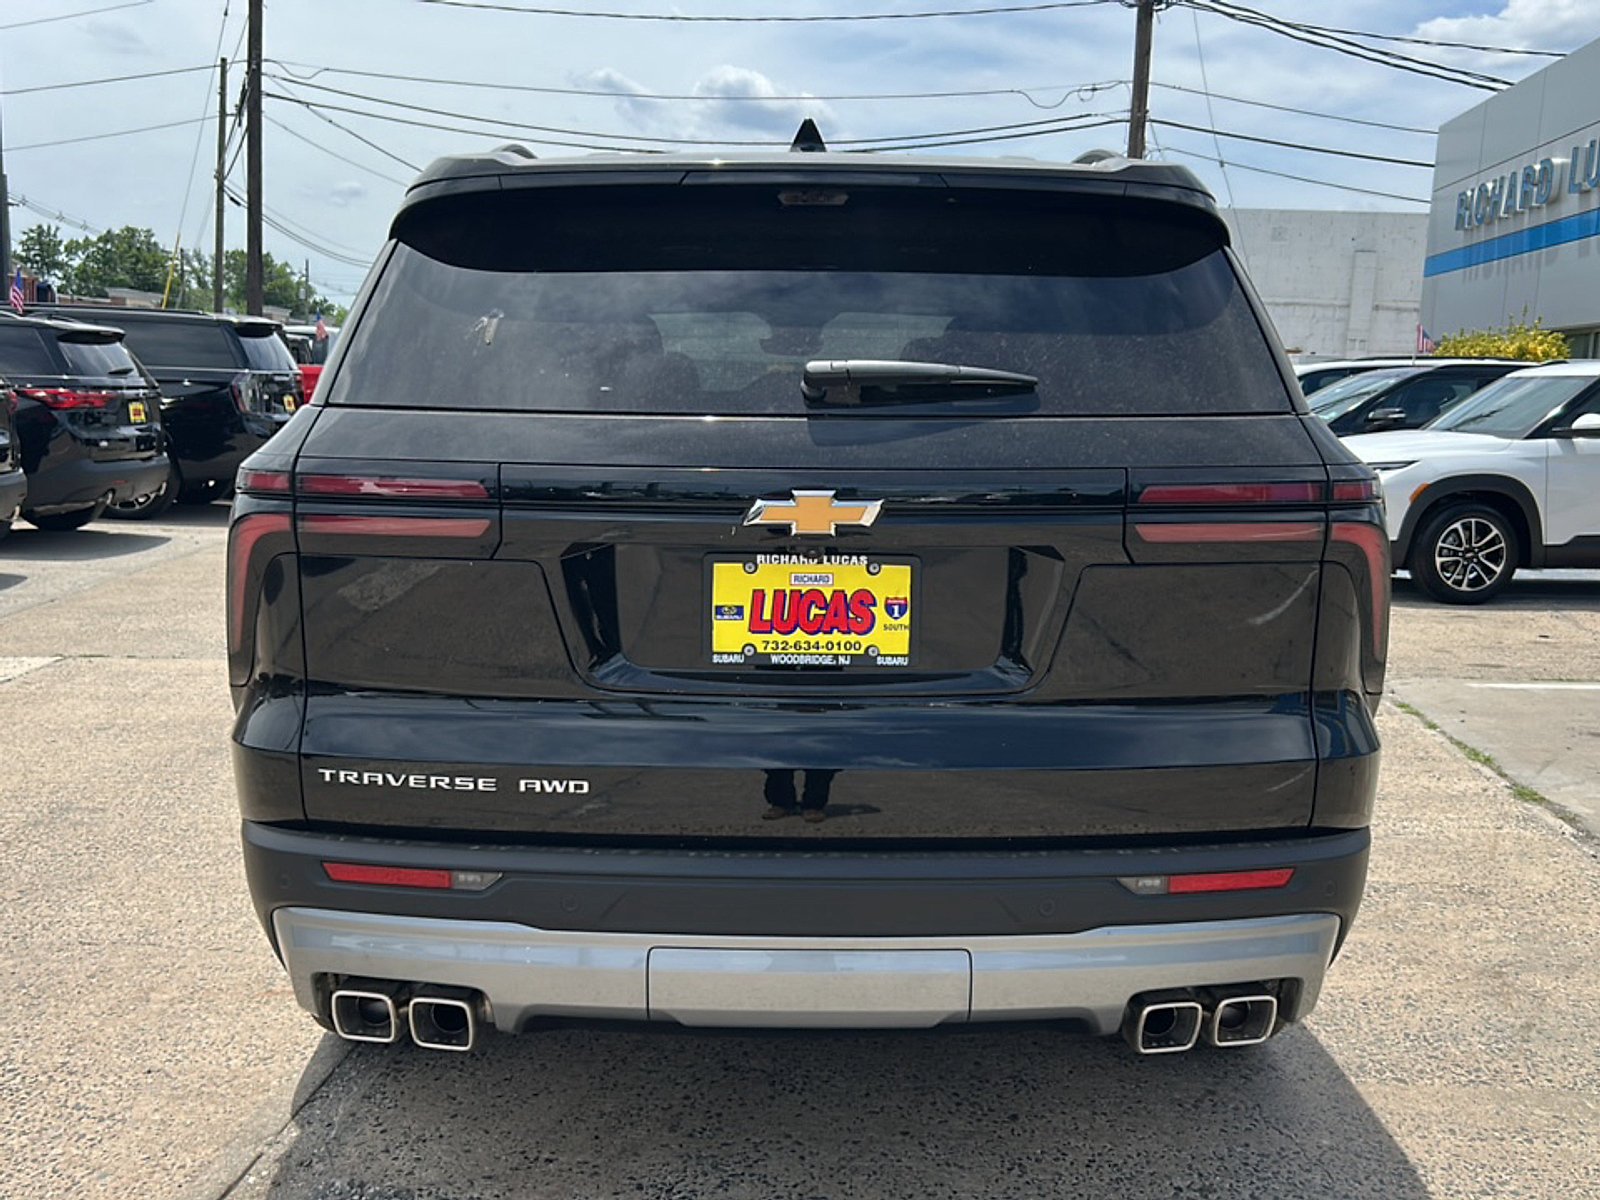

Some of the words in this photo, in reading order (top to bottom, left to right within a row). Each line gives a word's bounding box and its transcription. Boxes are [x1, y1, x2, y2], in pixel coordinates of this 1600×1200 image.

[1455, 158, 1555, 231] RICHARD
[823, 555, 868, 565] LUCAS
[793, 575, 830, 583] RICHARD
[749, 588, 877, 635] LUCAS
[891, 604, 900, 617] 1
[762, 641, 862, 651] 732-634-0100
[712, 653, 745, 663] SUBARU
[838, 655, 850, 665] NJ
[876, 656, 909, 666] SUBARU
[318, 768, 497, 792] TRAVERSE
[519, 778, 590, 794] AWD
